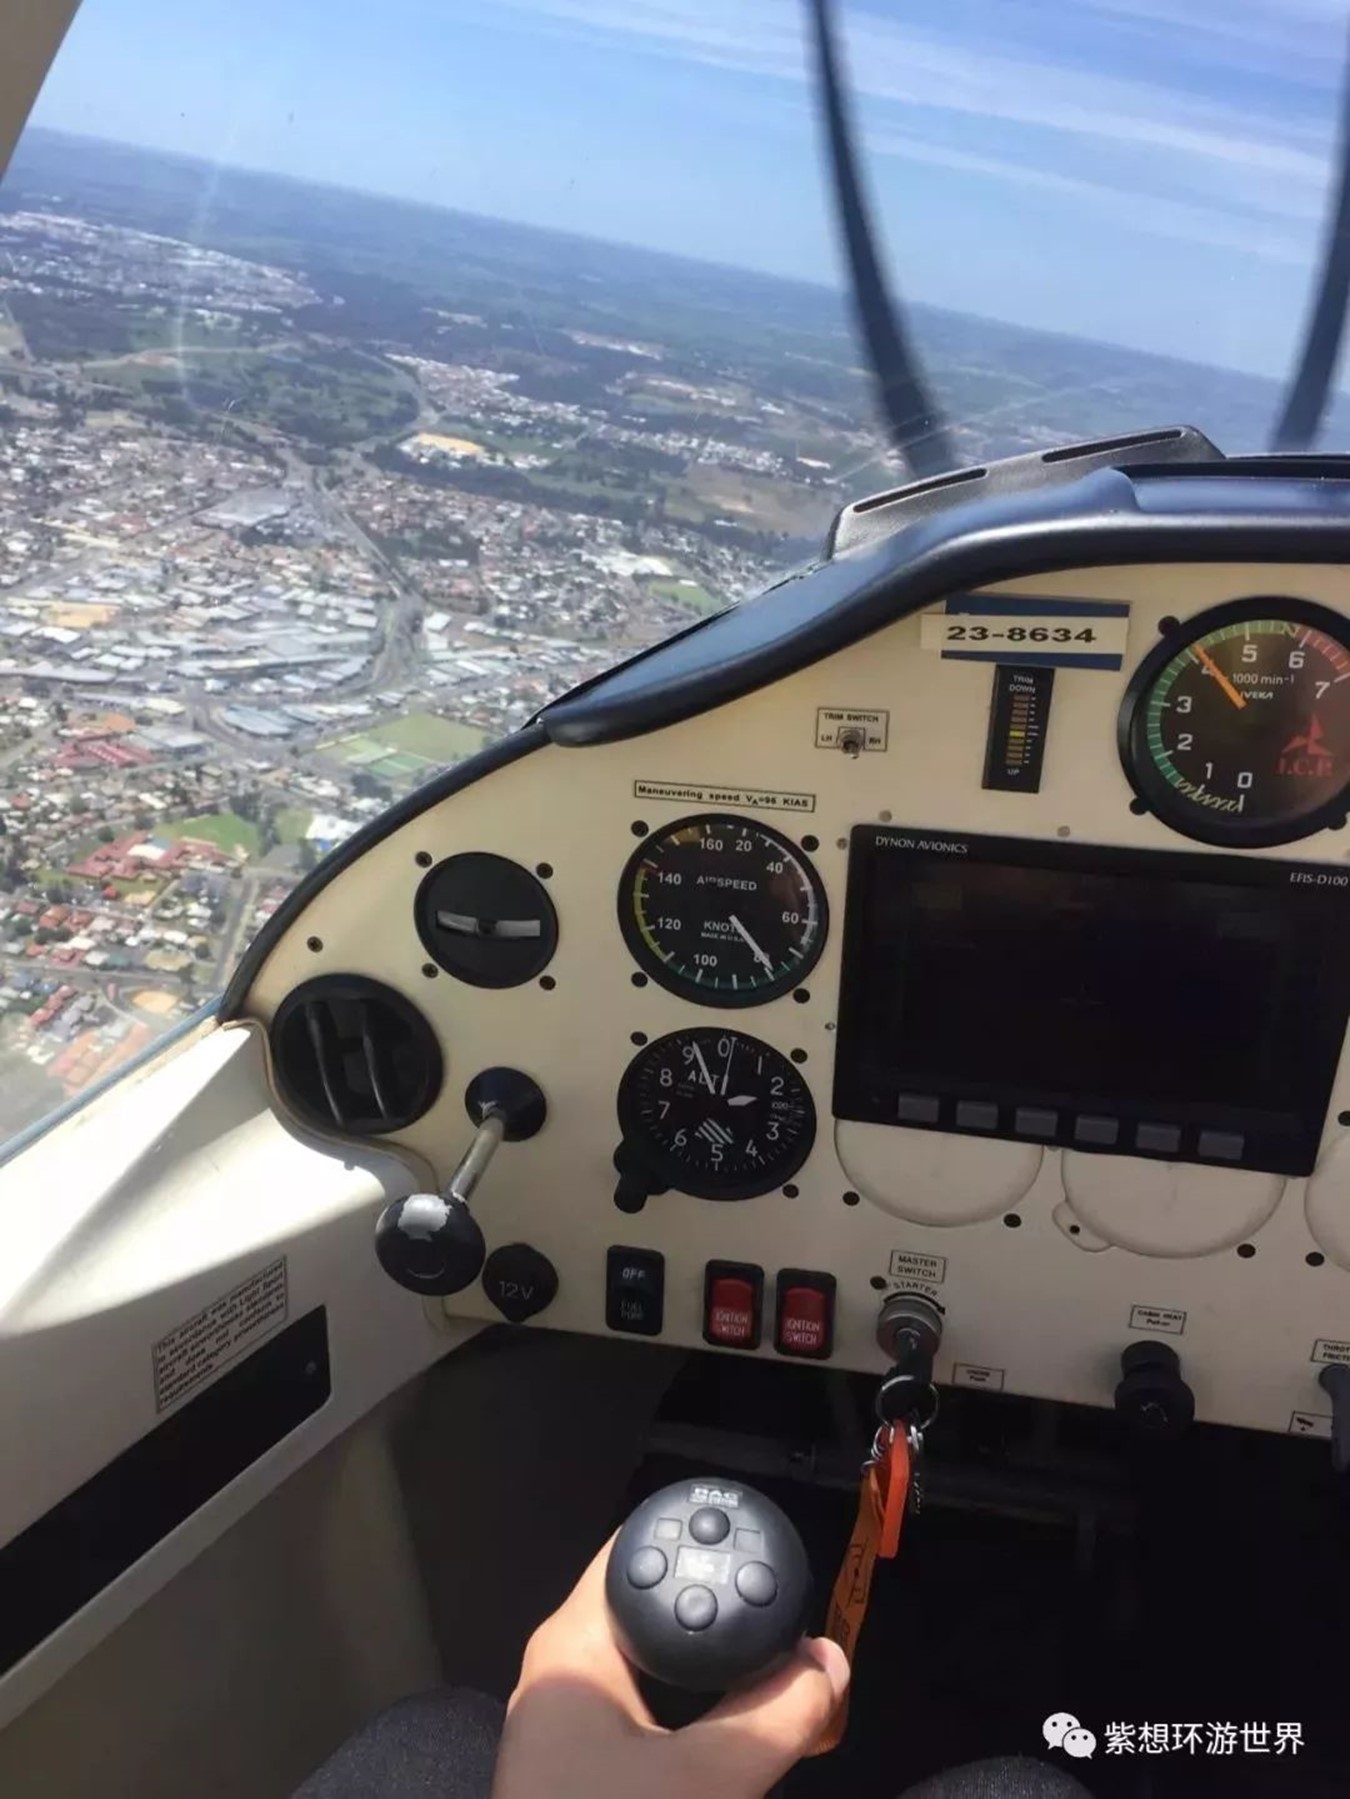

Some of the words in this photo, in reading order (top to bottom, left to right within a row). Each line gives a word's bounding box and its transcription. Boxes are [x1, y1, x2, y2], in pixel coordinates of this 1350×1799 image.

[946, 625, 1097, 645] 23-8634
[1241, 644, 1258, 663] 5
[1288, 651, 1306, 669] 6
[1232, 673, 1258, 685] 1000
[1009, 684, 1036, 694] DOWN
[1315, 681, 1330, 699] 7
[1176, 696, 1192, 714] 3
[824, 712, 844, 720] TRIM
[847, 714, 879, 722] SWITCH
[1177, 733, 1193, 751] 2
[1205, 762, 1213, 780] 1
[1237, 772, 1253, 789] 0
[638, 785, 703, 800] Maneuvering
[709, 793, 740, 803] speed
[782, 797, 809, 808] KIAS
[700, 839, 723, 851] 160
[735, 840, 752, 852] 20
[875, 835, 914, 849] DYNON
[917, 839, 968, 854] AVIONICS
[766, 861, 783, 874] 40
[658, 872, 682, 885] 140
[1290, 871, 1349, 887] EFIS-D100
[658, 917, 681, 930] 120
[782, 911, 799, 924] 60
[704, 920, 742, 934] KNOT
[693, 953, 718, 967] 100
[682, 1046, 695, 1065] 9
[717, 1038, 730, 1058] 0
[659, 1067, 673, 1086] 8
[688, 1069, 720, 1087] ALT
[770, 1076, 785, 1096] 2
[658, 1100, 670, 1119] 7
[673, 1128, 687, 1147] 6
[766, 1122, 779, 1141] 3
[711, 1143, 724, 1162] 5
[746, 1139, 758, 1157] 4
[898, 1255, 937, 1268] MASTER
[622, 1267, 646, 1280] OFF
[898, 1265, 937, 1278] SWITCH
[499, 1280, 534, 1300] 12V
[893, 1281, 938, 1297] STARTER
